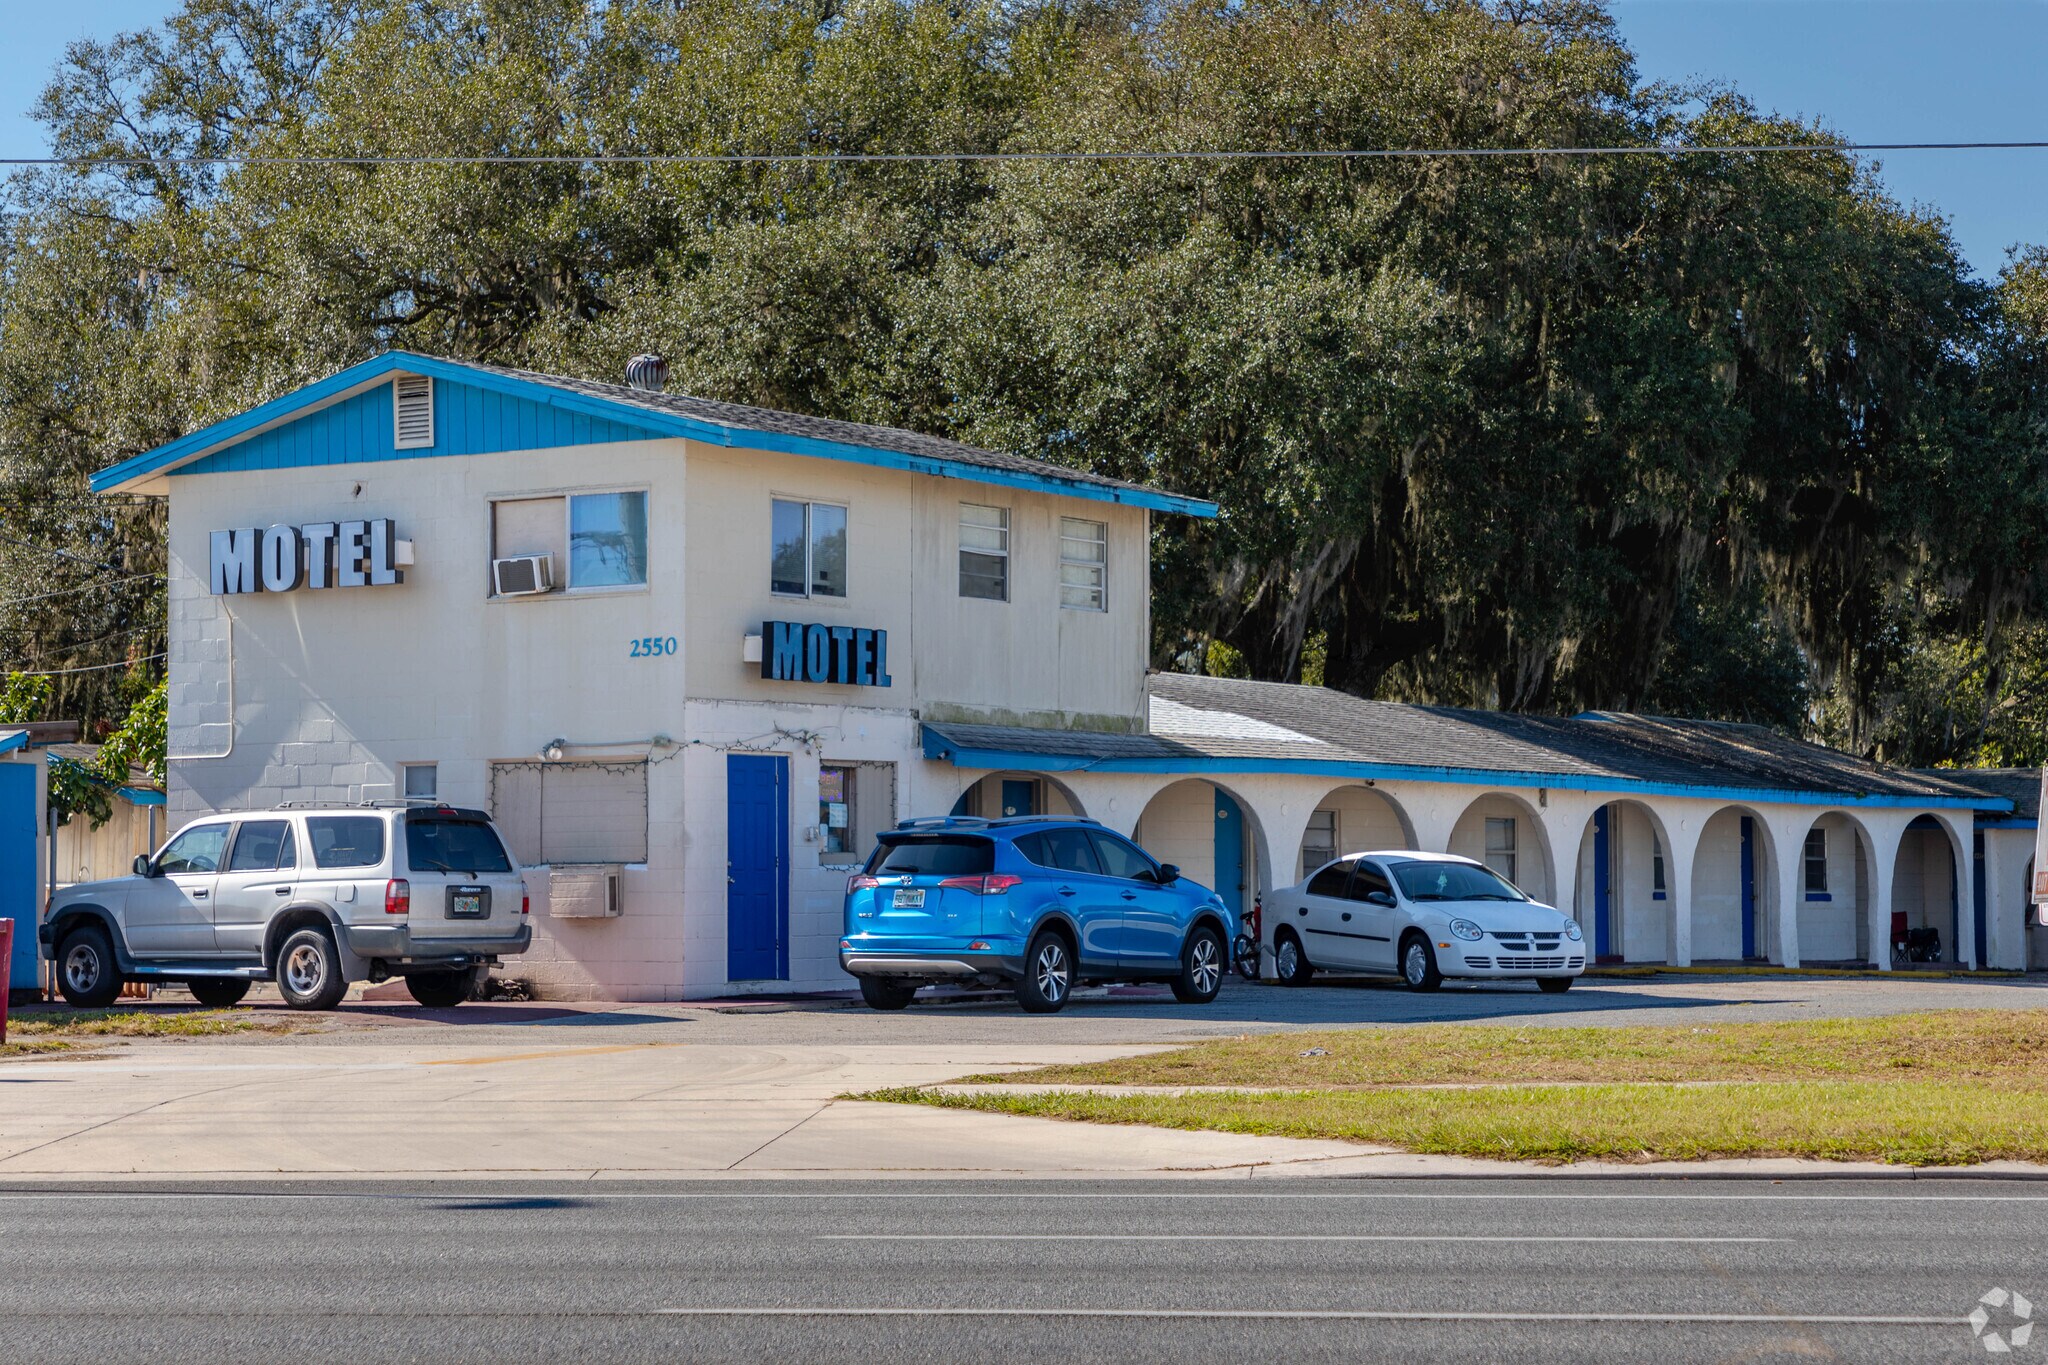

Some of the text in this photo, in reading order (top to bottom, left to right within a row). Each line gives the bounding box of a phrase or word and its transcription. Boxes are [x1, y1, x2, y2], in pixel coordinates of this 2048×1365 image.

[209, 518, 403, 595] MOTEL
[629, 636, 678, 657] 2550
[761, 620, 891, 687] MOTEL
